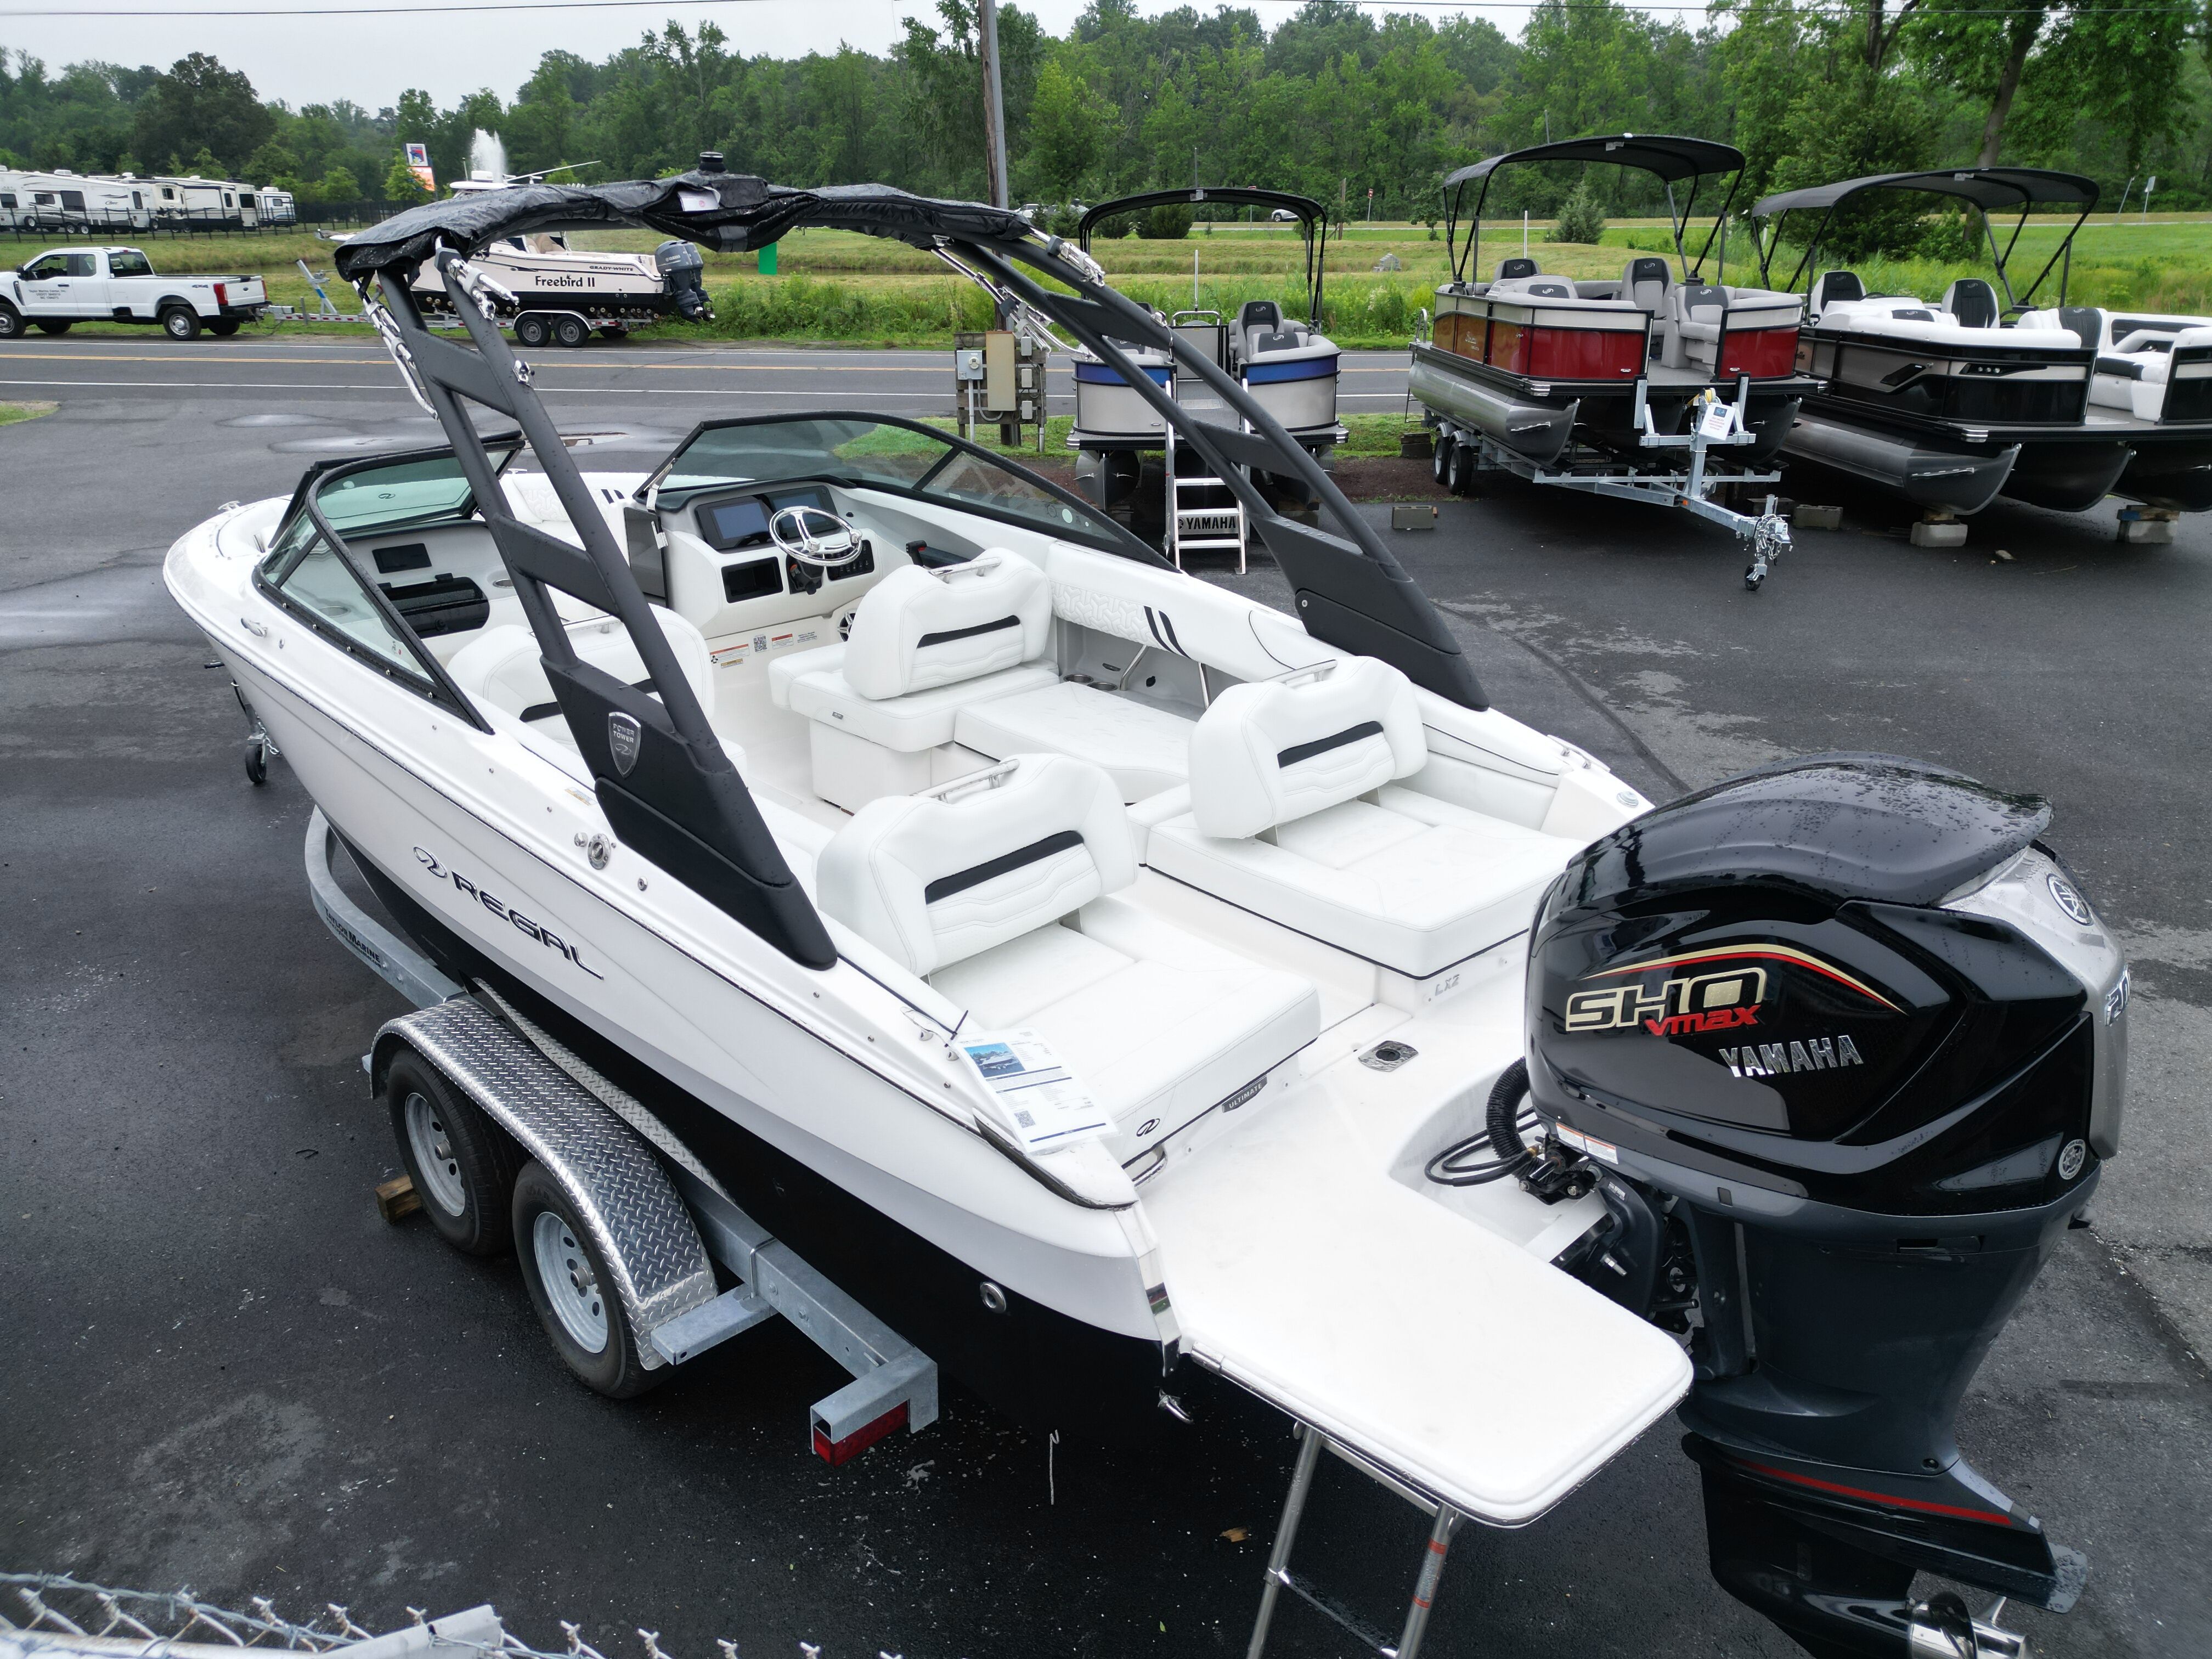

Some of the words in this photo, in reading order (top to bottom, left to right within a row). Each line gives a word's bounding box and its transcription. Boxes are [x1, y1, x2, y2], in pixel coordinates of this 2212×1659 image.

[535, 275, 583, 287] Freebird
[588, 277, 595, 287] II
[1186, 516, 1236, 530] YAMAHA
[613, 723, 635, 737] POWER
[613, 730, 634, 743] TOWER
[450, 869, 605, 980] REGAL
[348, 930, 381, 964] MARINE
[1565, 967, 1767, 1032] SHO
[1718, 1035, 1864, 1078] YAMAHA
[1228, 1082, 1263, 1109] ULTIMATE
